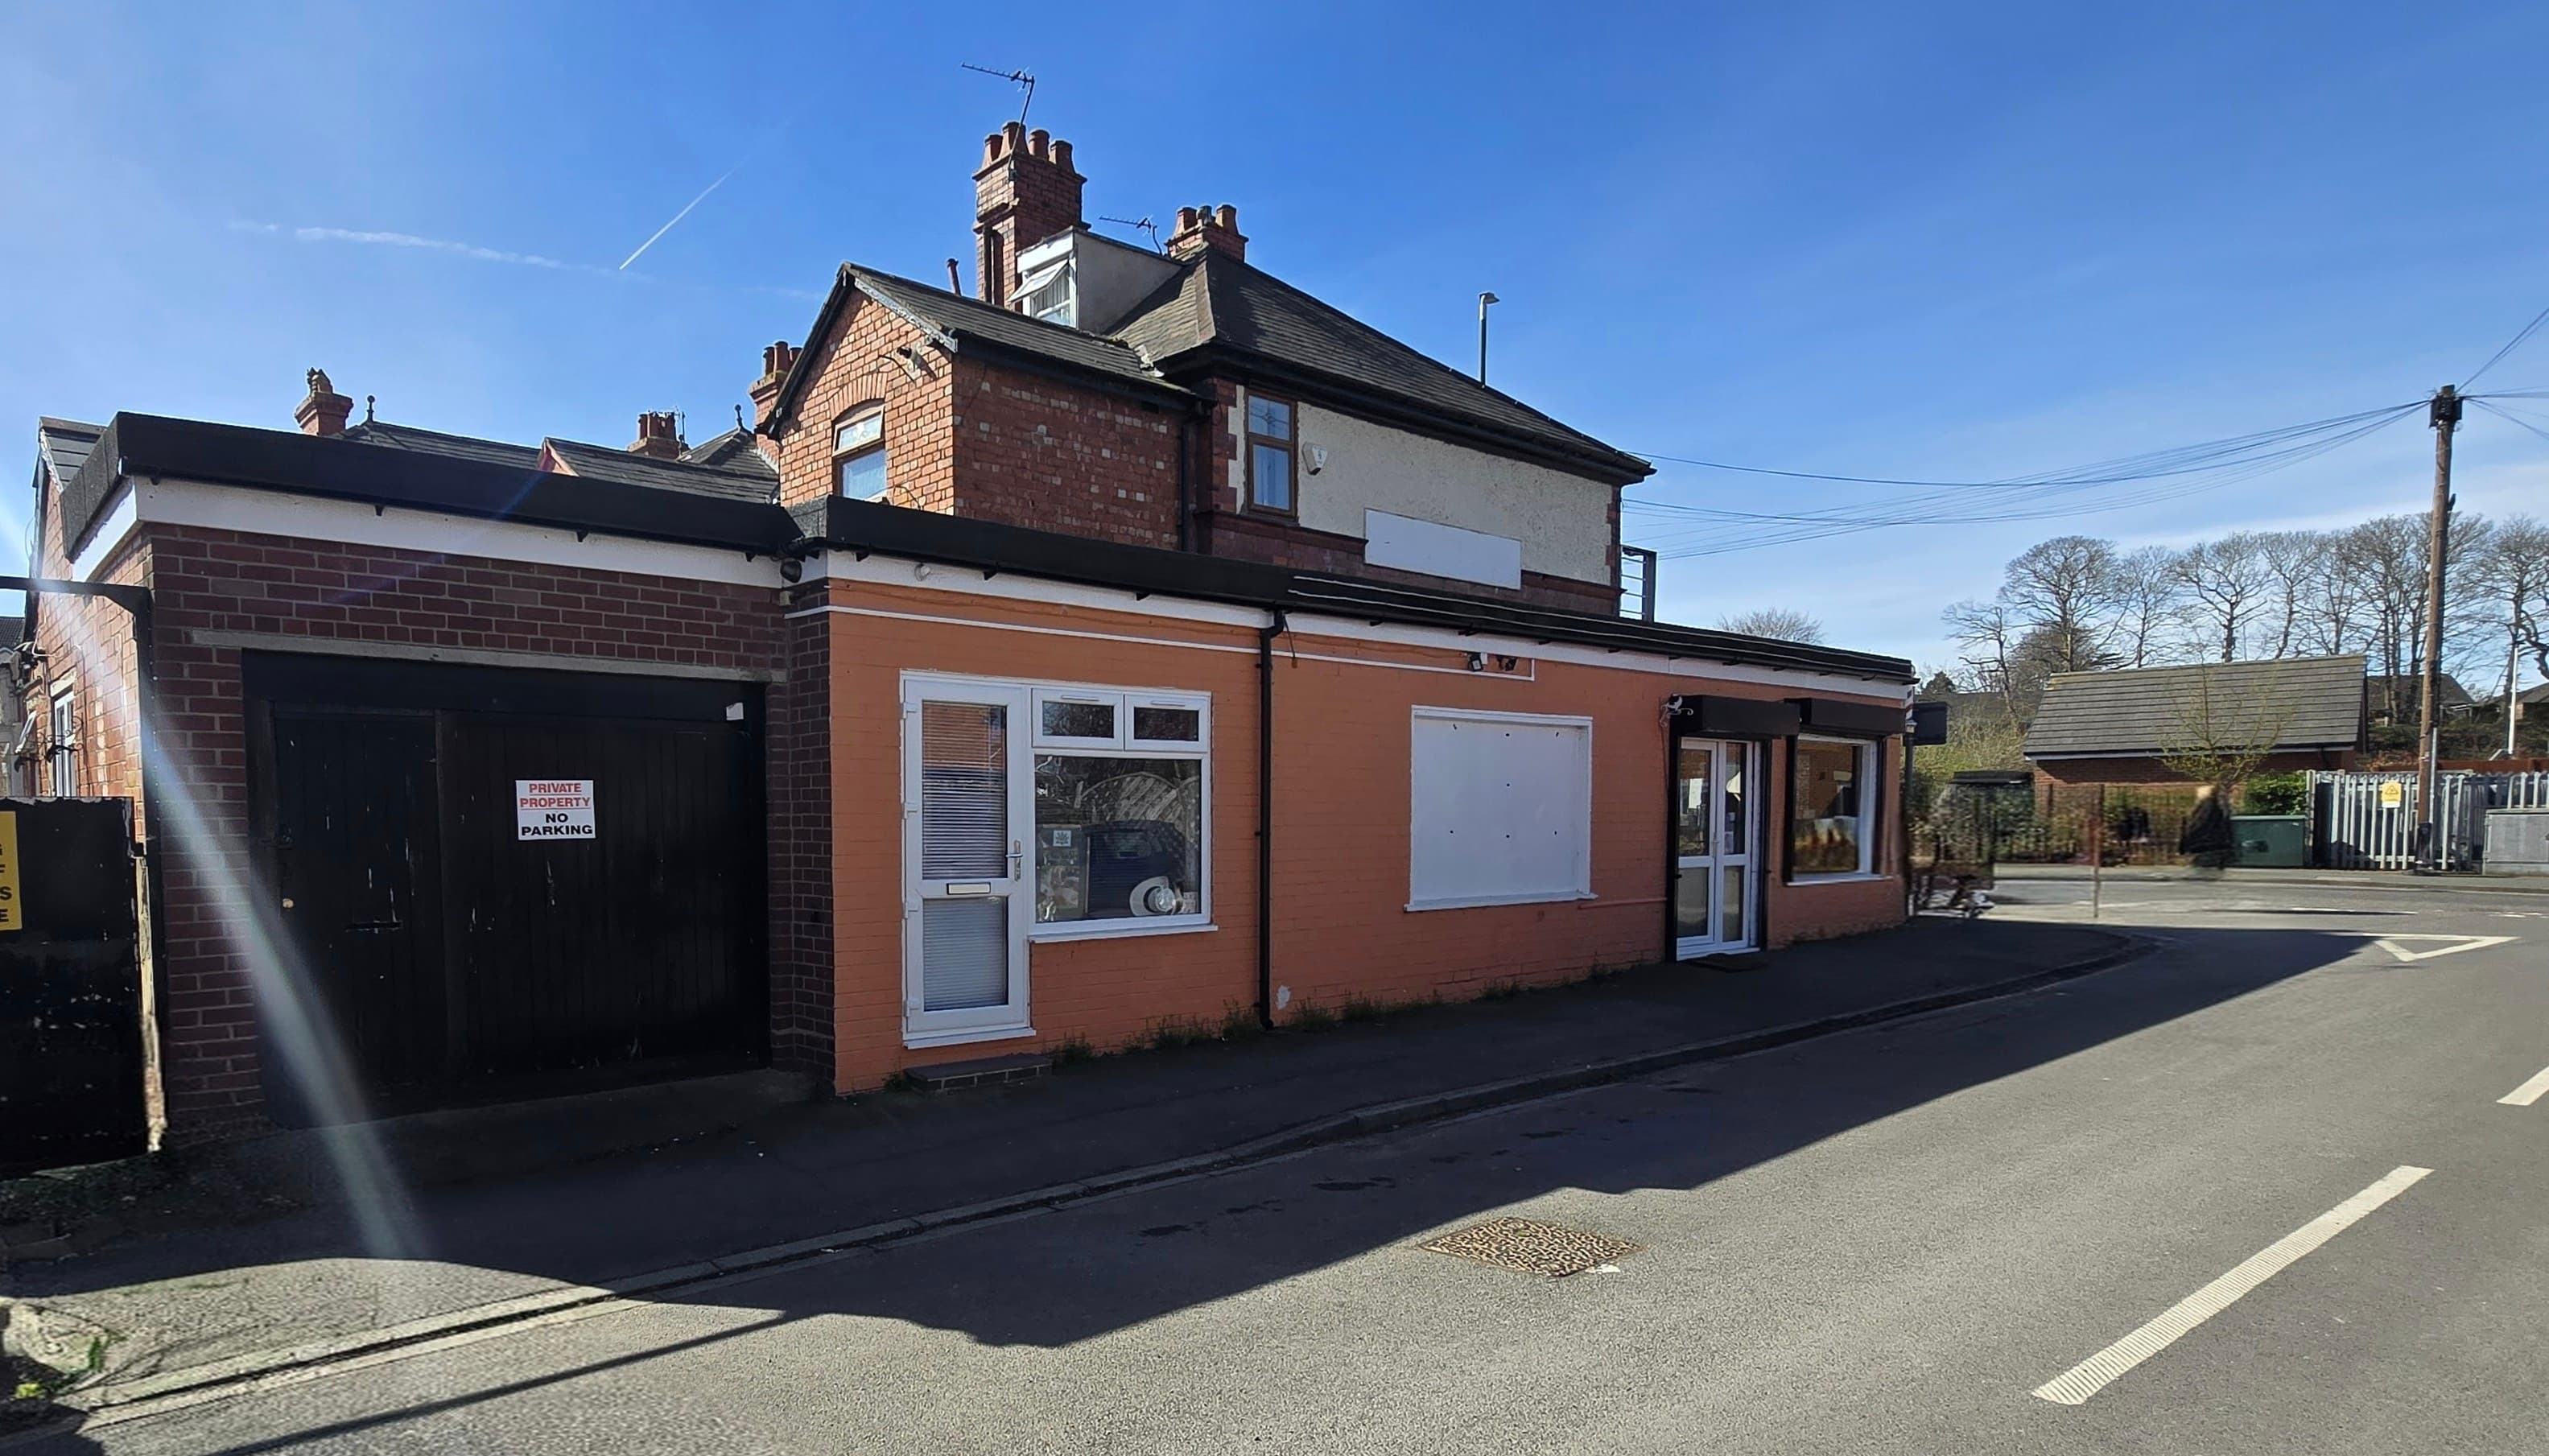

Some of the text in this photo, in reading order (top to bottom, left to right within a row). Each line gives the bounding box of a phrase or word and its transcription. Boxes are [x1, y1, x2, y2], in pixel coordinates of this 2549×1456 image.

[529, 782, 582, 793] PRIVATE
[520, 797, 591, 807] PROPERTY
[545, 813, 568, 823] NO
[521, 825, 592, 835] PARKING
